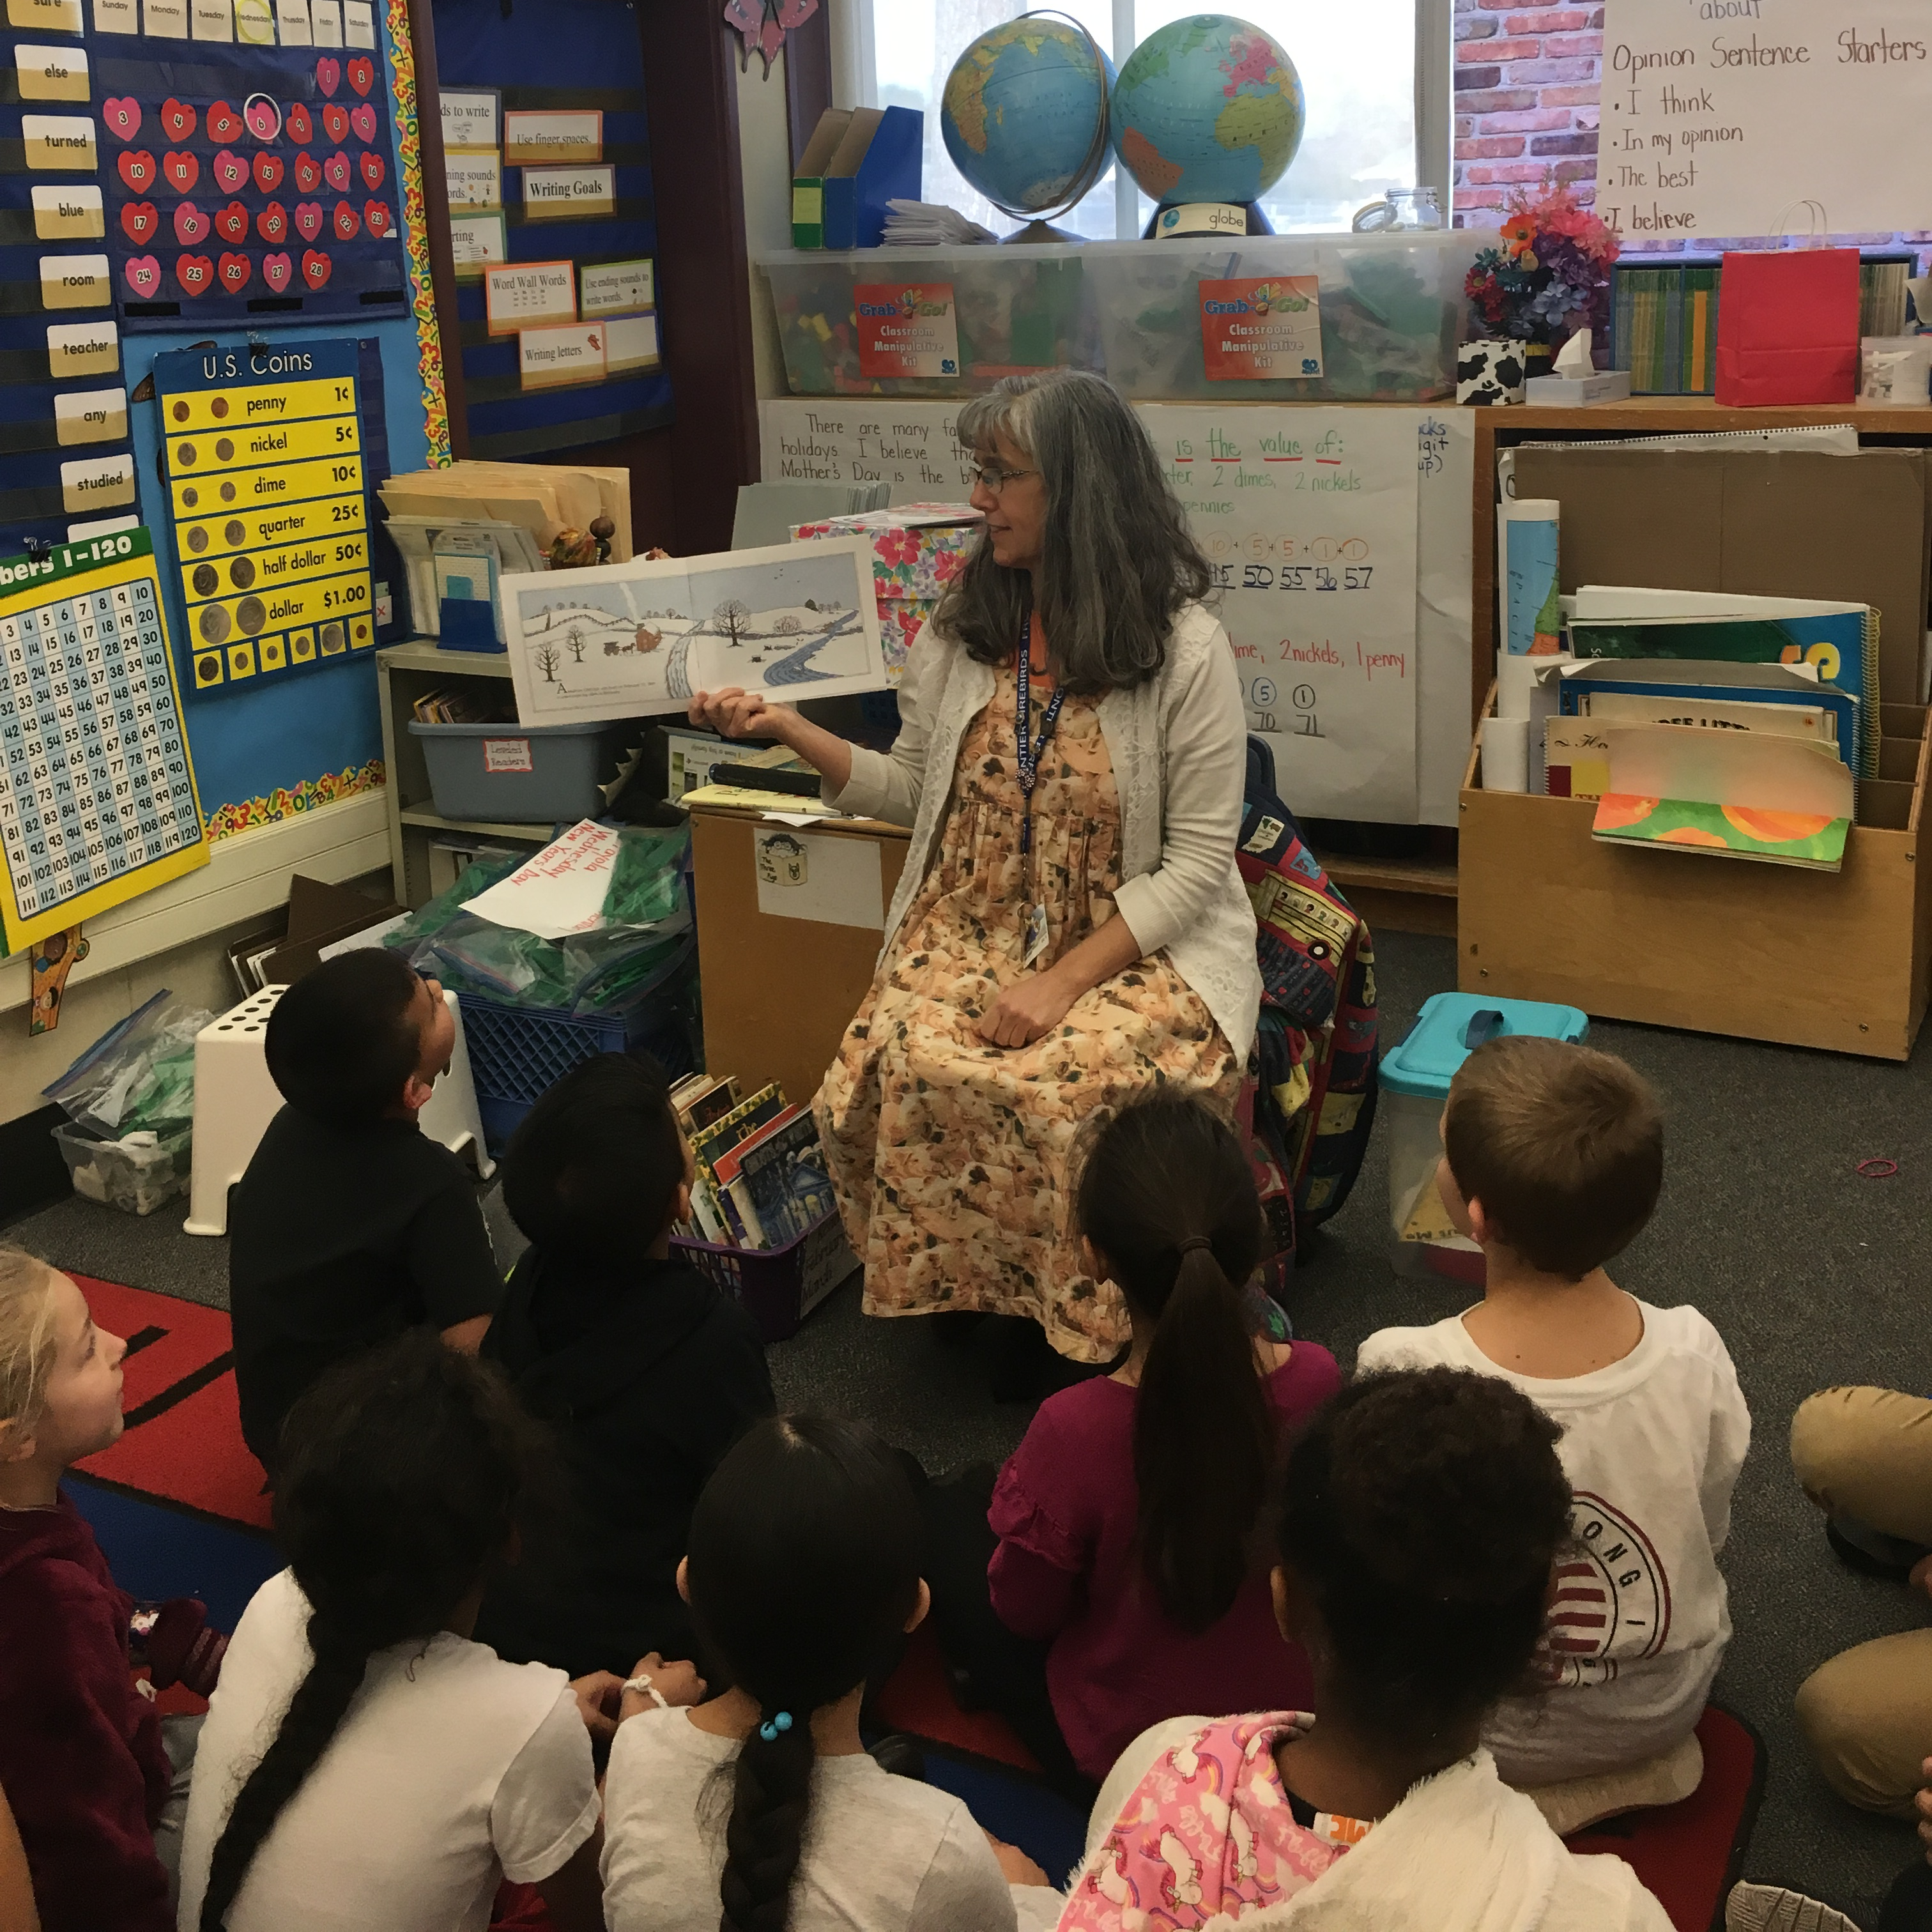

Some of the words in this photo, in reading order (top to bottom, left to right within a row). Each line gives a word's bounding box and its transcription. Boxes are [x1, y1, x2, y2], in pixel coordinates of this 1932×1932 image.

[102, 1, 128, 11] Sunday
[151, 5, 180, 15] Monday
[198, 10, 224, 20] Tuesday
[319, 18, 334, 26] Friday
[349, 19, 369, 28] Saturday
[1699, 0, 1762, 20] about
[1613, 44, 1694, 84] Opinion
[1710, 33, 1811, 68] Sentence
[1837, 28, 1926, 63] Starters
[45, 64, 68, 78] else
[326, 70, 331, 83] 1
[358, 70, 366, 83] 2
[1627, 89, 1641, 115] I
[1660, 84, 1715, 113] think
[454, 105, 463, 117] to
[466, 105, 490, 117] write
[119, 111, 128, 125] 3
[174, 114, 183, 128] 4
[218, 118, 229, 130] 5
[257, 118, 265, 130] 6
[296, 120, 304, 132] 7
[334, 118, 340, 130] 8
[362, 118, 369, 128] 9
[45, 134, 87, 148] turned
[517, 134, 533, 146] Use
[535, 133, 560, 148] finger
[562, 134, 592, 147] spaces.
[1621, 128, 1643, 151] In
[1652, 134, 1671, 155] my
[1682, 122, 1743, 153] opinion
[467, 170, 496, 181] sounds
[1618, 165, 1647, 187] The
[1658, 160, 1699, 188] best
[530, 183, 571, 199] Writing
[573, 180, 602, 195] Goals
[59, 203, 84, 218] blue
[1209, 210, 1244, 230] globe
[1607, 208, 1623, 233] I
[1632, 202, 1697, 231] believe
[63, 273, 95, 287] room
[492, 277, 515, 290] Word
[517, 275, 537, 288] Wall
[539, 274, 567, 286] Words
[598, 276, 618, 288] ending
[620, 273, 640, 284] sounds
[880, 325, 934, 336] Classroom
[1229, 323, 1292, 335] Classroom
[63, 340, 108, 355] teacher
[526, 349, 555, 362] Writing
[557, 346, 582, 358] letters
[875, 341, 943, 353] Manipulative
[1222, 340, 1303, 354] Manipulative
[203, 353, 242, 381] U.S.
[250, 351, 312, 375] Coins
[902, 356, 916, 366] Kit
[1255, 357, 1272, 367] Kit
[247, 396, 287, 417] penny
[334, 387, 349, 402] 1¢
[84, 410, 107, 424] any
[805, 413, 844, 434] There
[859, 424, 880, 435] are
[893, 424, 929, 442] many
[250, 433, 288, 453] nickel
[335, 425, 353, 442] 5¢
[1176, 440, 1193, 456] is
[1206, 428, 1241, 458] the
[1259, 431, 1303, 455] value
[1315, 430, 1344, 454] of:
[859, 438, 868, 458] I
[880, 441, 928, 460] believe
[77, 472, 123, 491] studied
[254, 477, 286, 494] dime
[332, 465, 356, 482] 10¢
[781, 460, 841, 480] Mother's
[852, 461, 880, 481] Day
[895, 469, 904, 482] is
[922, 466, 944, 484] the
[1213, 465, 1223, 487] 2
[1234, 466, 1276, 489] dimes,
[1295, 471, 1307, 489] 2
[1312, 469, 1361, 491] nickels
[1182, 500, 1236, 514] pennies
[258, 516, 305, 540] quarter
[331, 504, 359, 522] 25¢
[63, 535, 132, 567] 1-120
[1253, 539, 1263, 556] 5
[1284, 540, 1293, 556] 5
[263, 557, 288, 576] half
[290, 550, 326, 571] dollar
[335, 544, 362, 562] 50¢
[1243, 565, 1274, 586] 50
[1280, 567, 1312, 587] 55
[1315, 567, 1337, 588] 56
[1343, 567, 1373, 588] 57
[61, 609, 68, 620] 6
[79, 602, 87, 616] 7
[99, 597, 107, 610] 8
[118, 592, 126, 604] 9
[136, 586, 148, 600] 10
[268, 600, 305, 619] dollar
[323, 585, 365, 608] $1.00
[1365, 654, 1404, 681] penny
[1261, 686, 1269, 701] 5
[1254, 712, 1275, 730] 70
[1296, 714, 1317, 733] 71
[491, 743, 522, 753] Leveled
[491, 756, 525, 765] Readers
[567, 823, 595, 841] New
[533, 845, 572, 866] Years
[540, 831, 613, 878] Wednesday
[510, 869, 540, 886] Day
